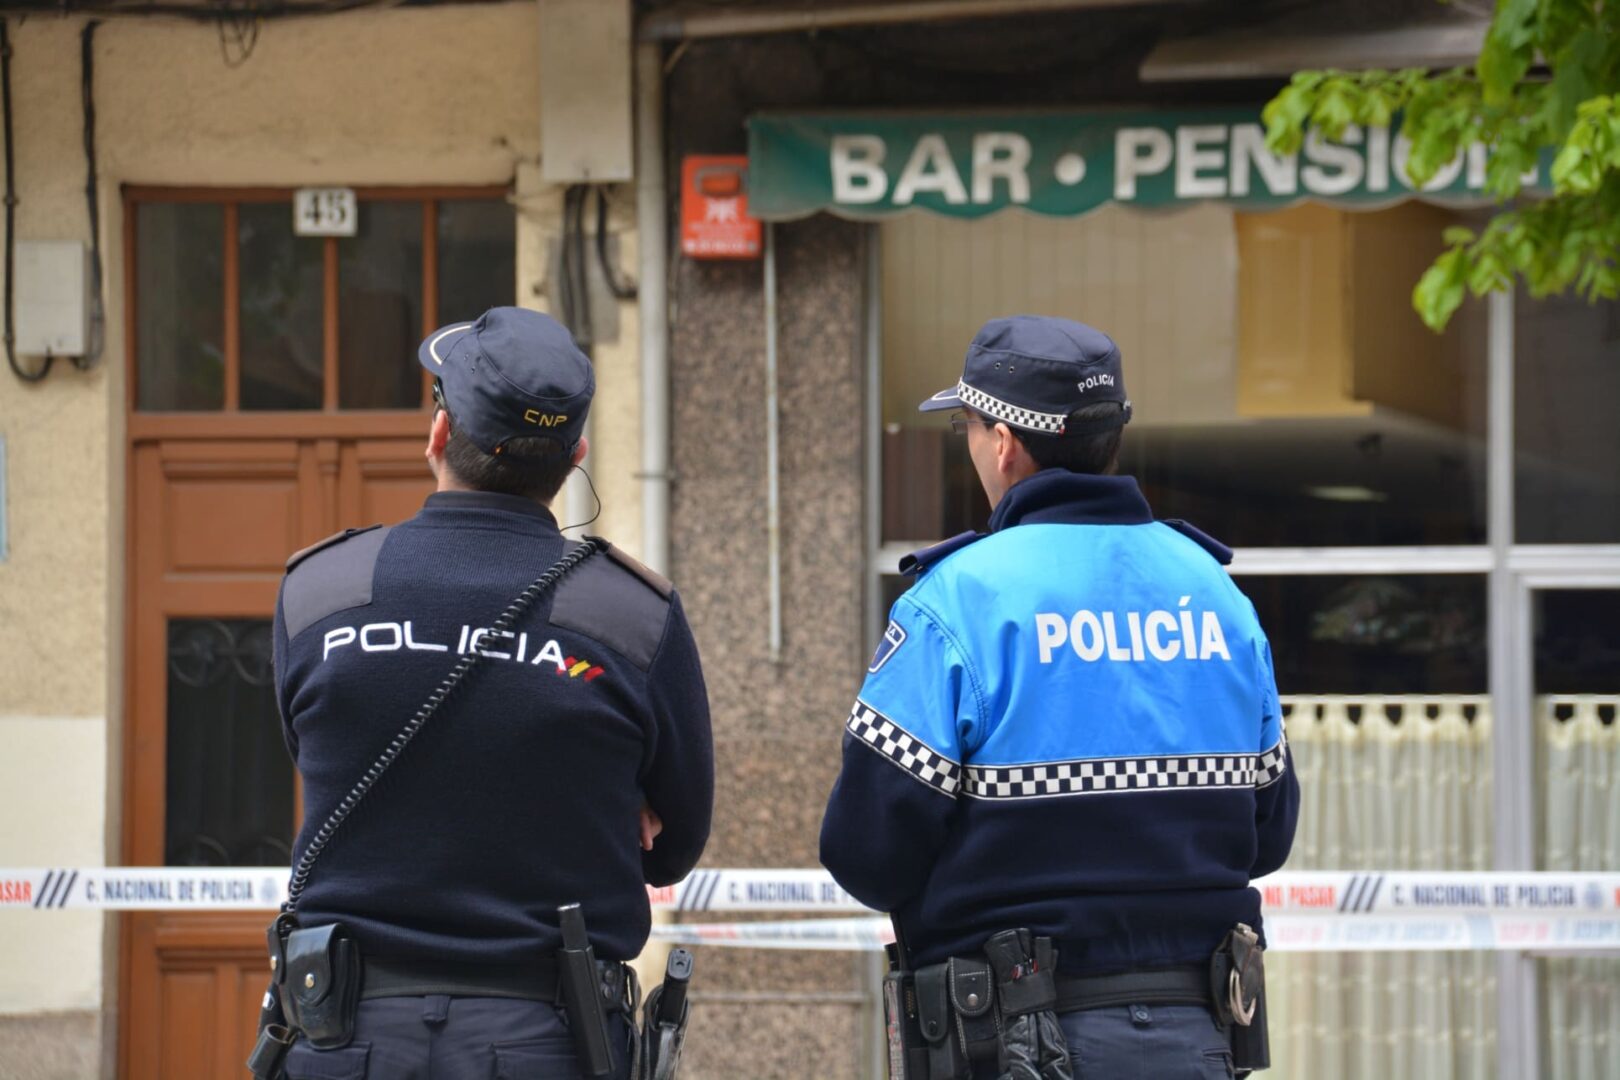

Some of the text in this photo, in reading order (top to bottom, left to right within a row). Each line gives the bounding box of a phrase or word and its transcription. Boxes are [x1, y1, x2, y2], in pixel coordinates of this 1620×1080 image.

[830, 132, 1032, 204] BAR
[304, 191, 346, 226] 45
[1077, 373, 1115, 393] POLICIA
[524, 408, 568, 427] CNP
[1034, 595, 1233, 664] POLICÍA
[323, 620, 567, 672] POLICIA
[104, 880, 173, 902] NACIONAL
[178, 879, 195, 902] DE
[201, 879, 255, 902] POLICIA
[746, 881, 816, 903] NACIONAL
[820, 881, 837, 903] DE
[1413, 884, 1486, 907] NACIONAL
[1494, 884, 1511, 907] DE
[1518, 884, 1576, 908] POLICIA
